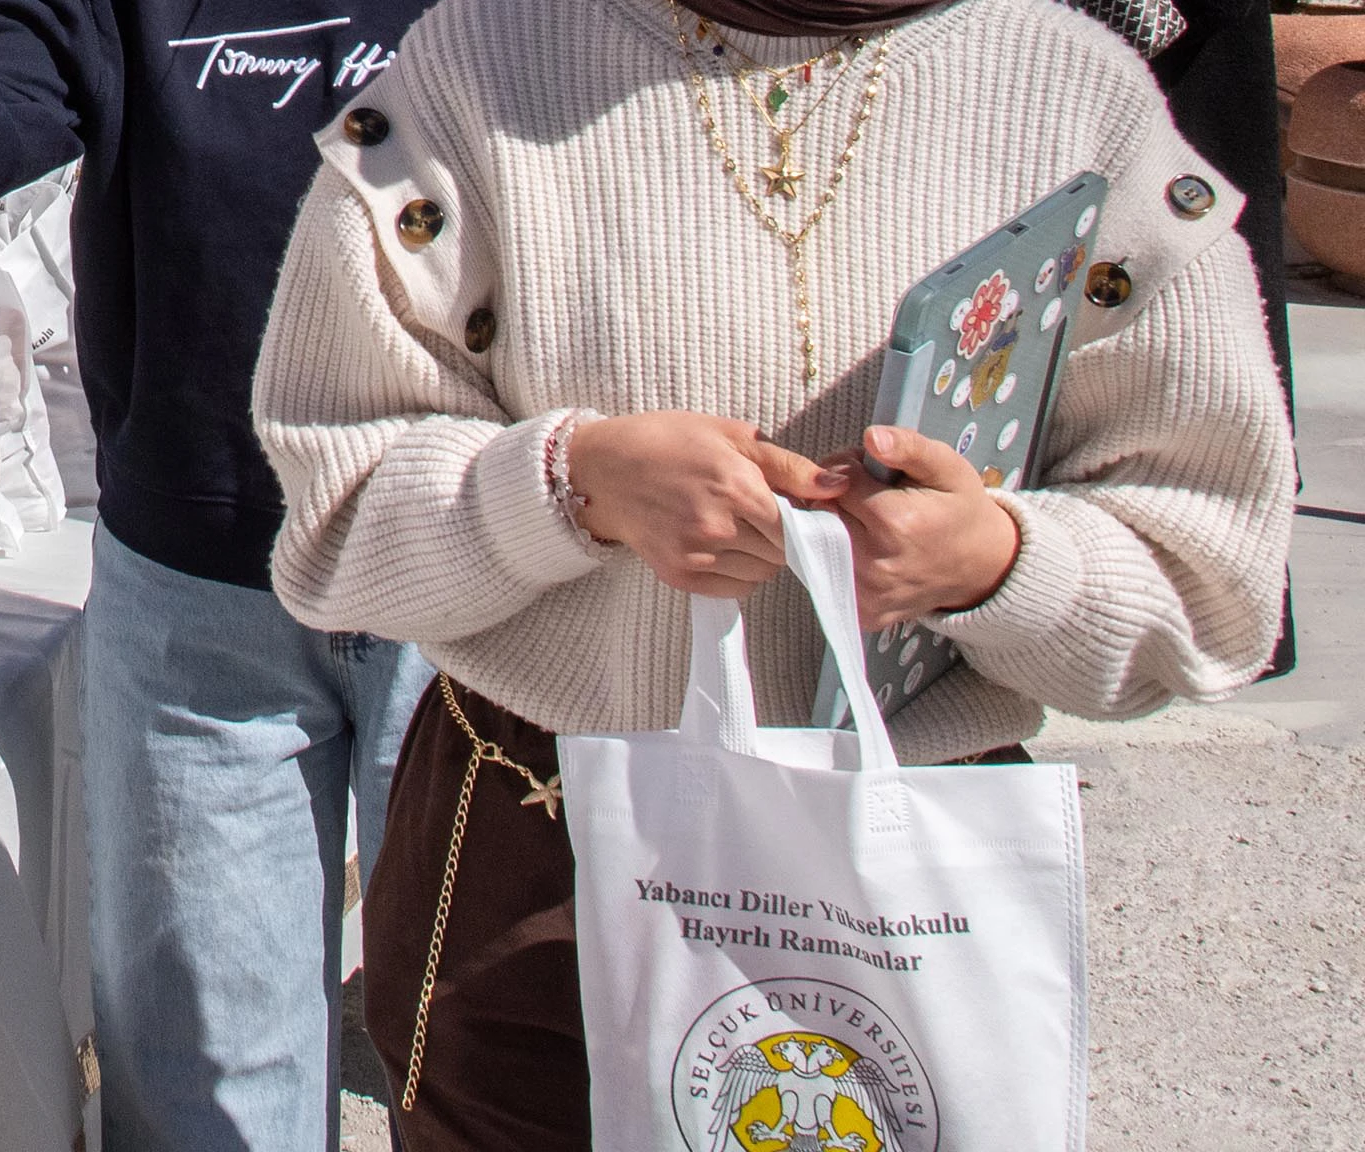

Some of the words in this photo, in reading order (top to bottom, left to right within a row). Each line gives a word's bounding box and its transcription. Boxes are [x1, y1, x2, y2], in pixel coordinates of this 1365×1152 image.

[168, 16, 350, 109] Tommy
[635, 878, 731, 909] Yabancı
[739, 888, 814, 919] Diller
[818, 899, 972, 937] Yüksekokulu
[680, 915, 770, 948] Hayırlı
[778, 927, 923, 972] Ramazanlar
[690, 1003, 759, 1099] SELÇUK
[765, 991, 927, 1129] ÜNİVERSİTESİ
